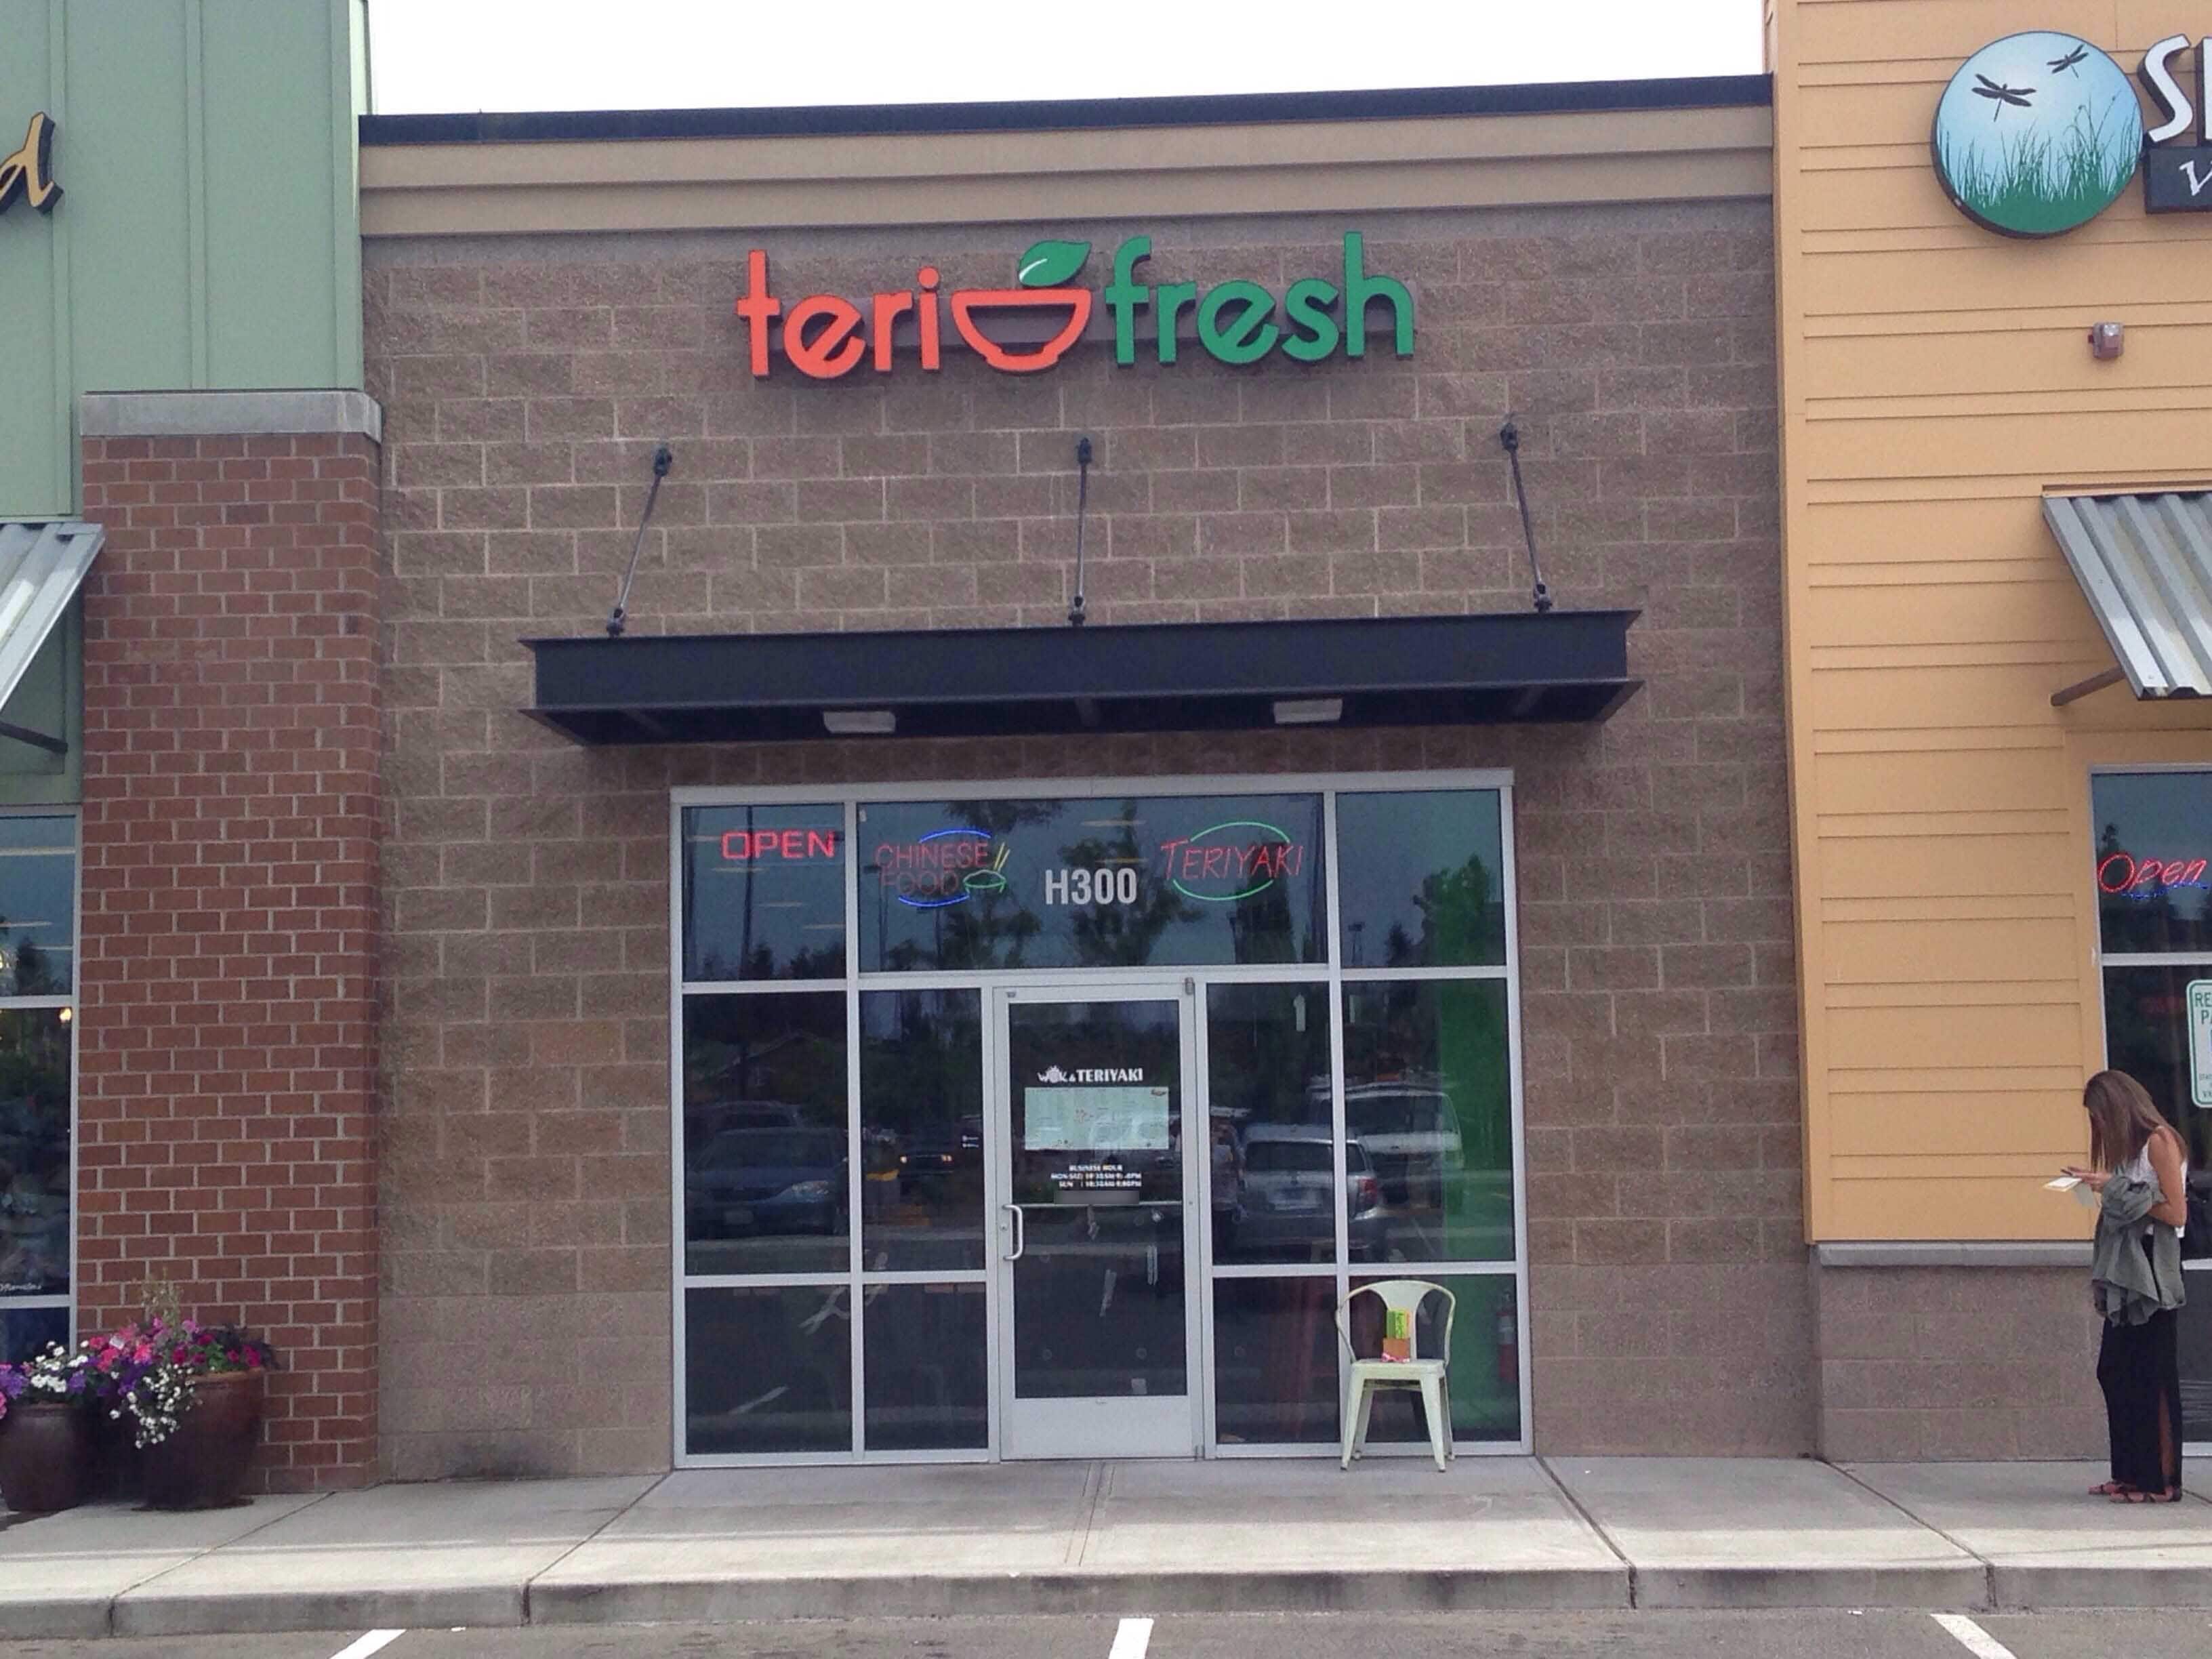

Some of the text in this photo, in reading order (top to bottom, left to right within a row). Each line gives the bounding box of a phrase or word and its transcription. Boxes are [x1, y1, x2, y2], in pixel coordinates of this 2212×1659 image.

[736, 231, 1416, 378] teri fresh
[721, 830, 836, 860] OPEN
[875, 840, 989, 869] CHINESE
[1160, 838, 1305, 880] TERIYAKI
[880, 867, 960, 895] FOOD
[1045, 867, 1137, 905] H300
[2098, 853, 2208, 893] Open
[1076, 1067, 1144, 1083] TERIYAKI
